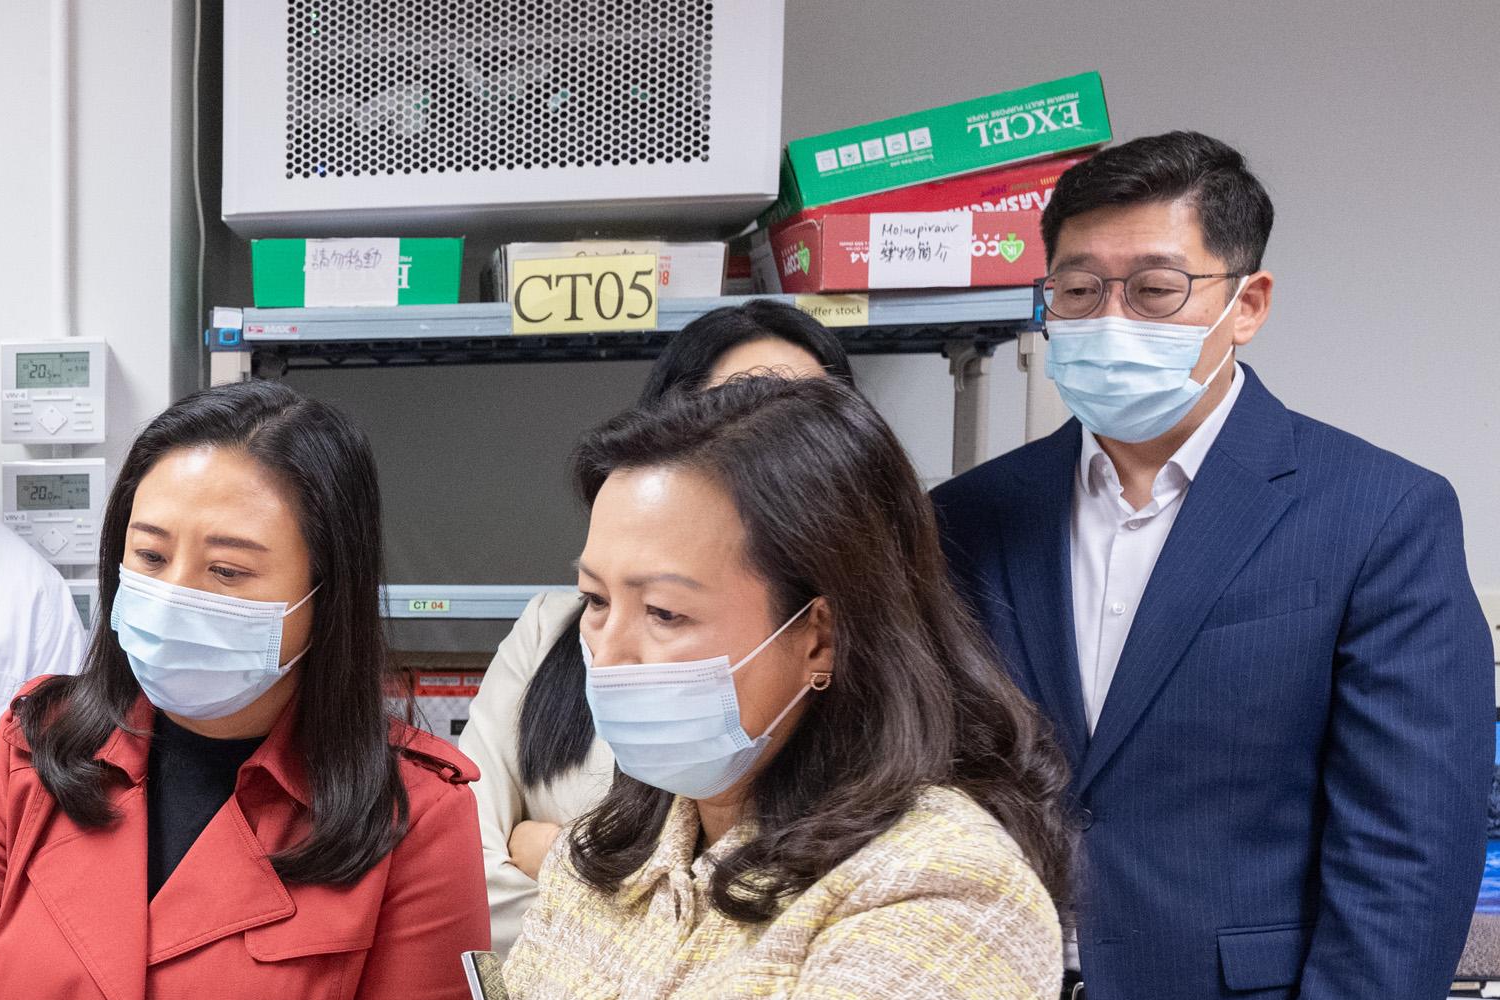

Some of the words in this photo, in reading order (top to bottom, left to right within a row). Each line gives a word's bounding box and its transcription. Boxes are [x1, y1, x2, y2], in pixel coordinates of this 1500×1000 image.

[967, 100, 1083, 148] EXCEL
[972, 241, 1000, 257] CO
[514, 268, 653, 323] CT05
[836, 304, 862, 316] stock
[413, 601, 428, 610] CT
[431, 601, 444, 610] 04
